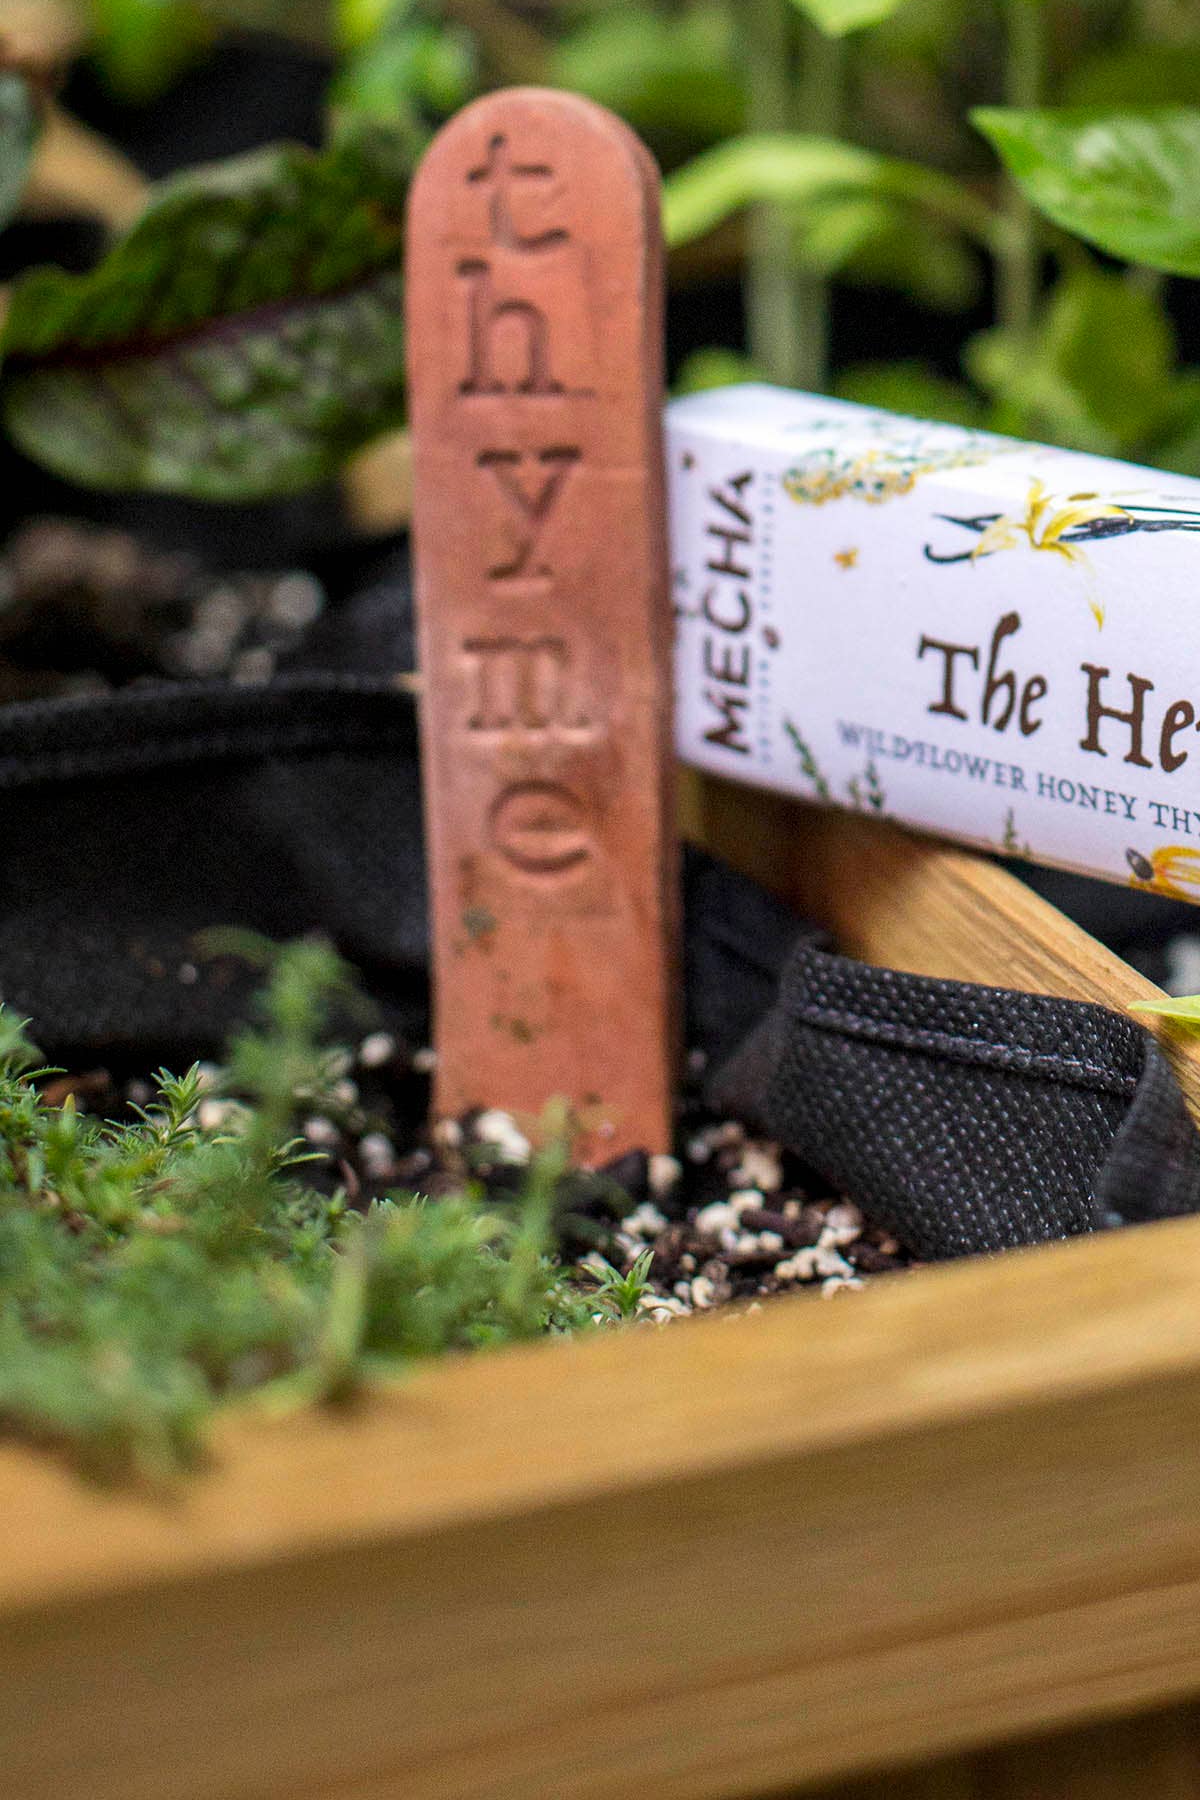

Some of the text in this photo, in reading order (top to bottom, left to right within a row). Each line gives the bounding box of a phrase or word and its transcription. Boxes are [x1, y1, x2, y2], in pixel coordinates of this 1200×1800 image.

[456, 132, 597, 878] thyme
[702, 468, 755, 757] MECHA
[918, 611, 1049, 737] The
[837, 720, 1028, 792] WILDFLOWER
[1036, 771, 1138, 822] HONEY
